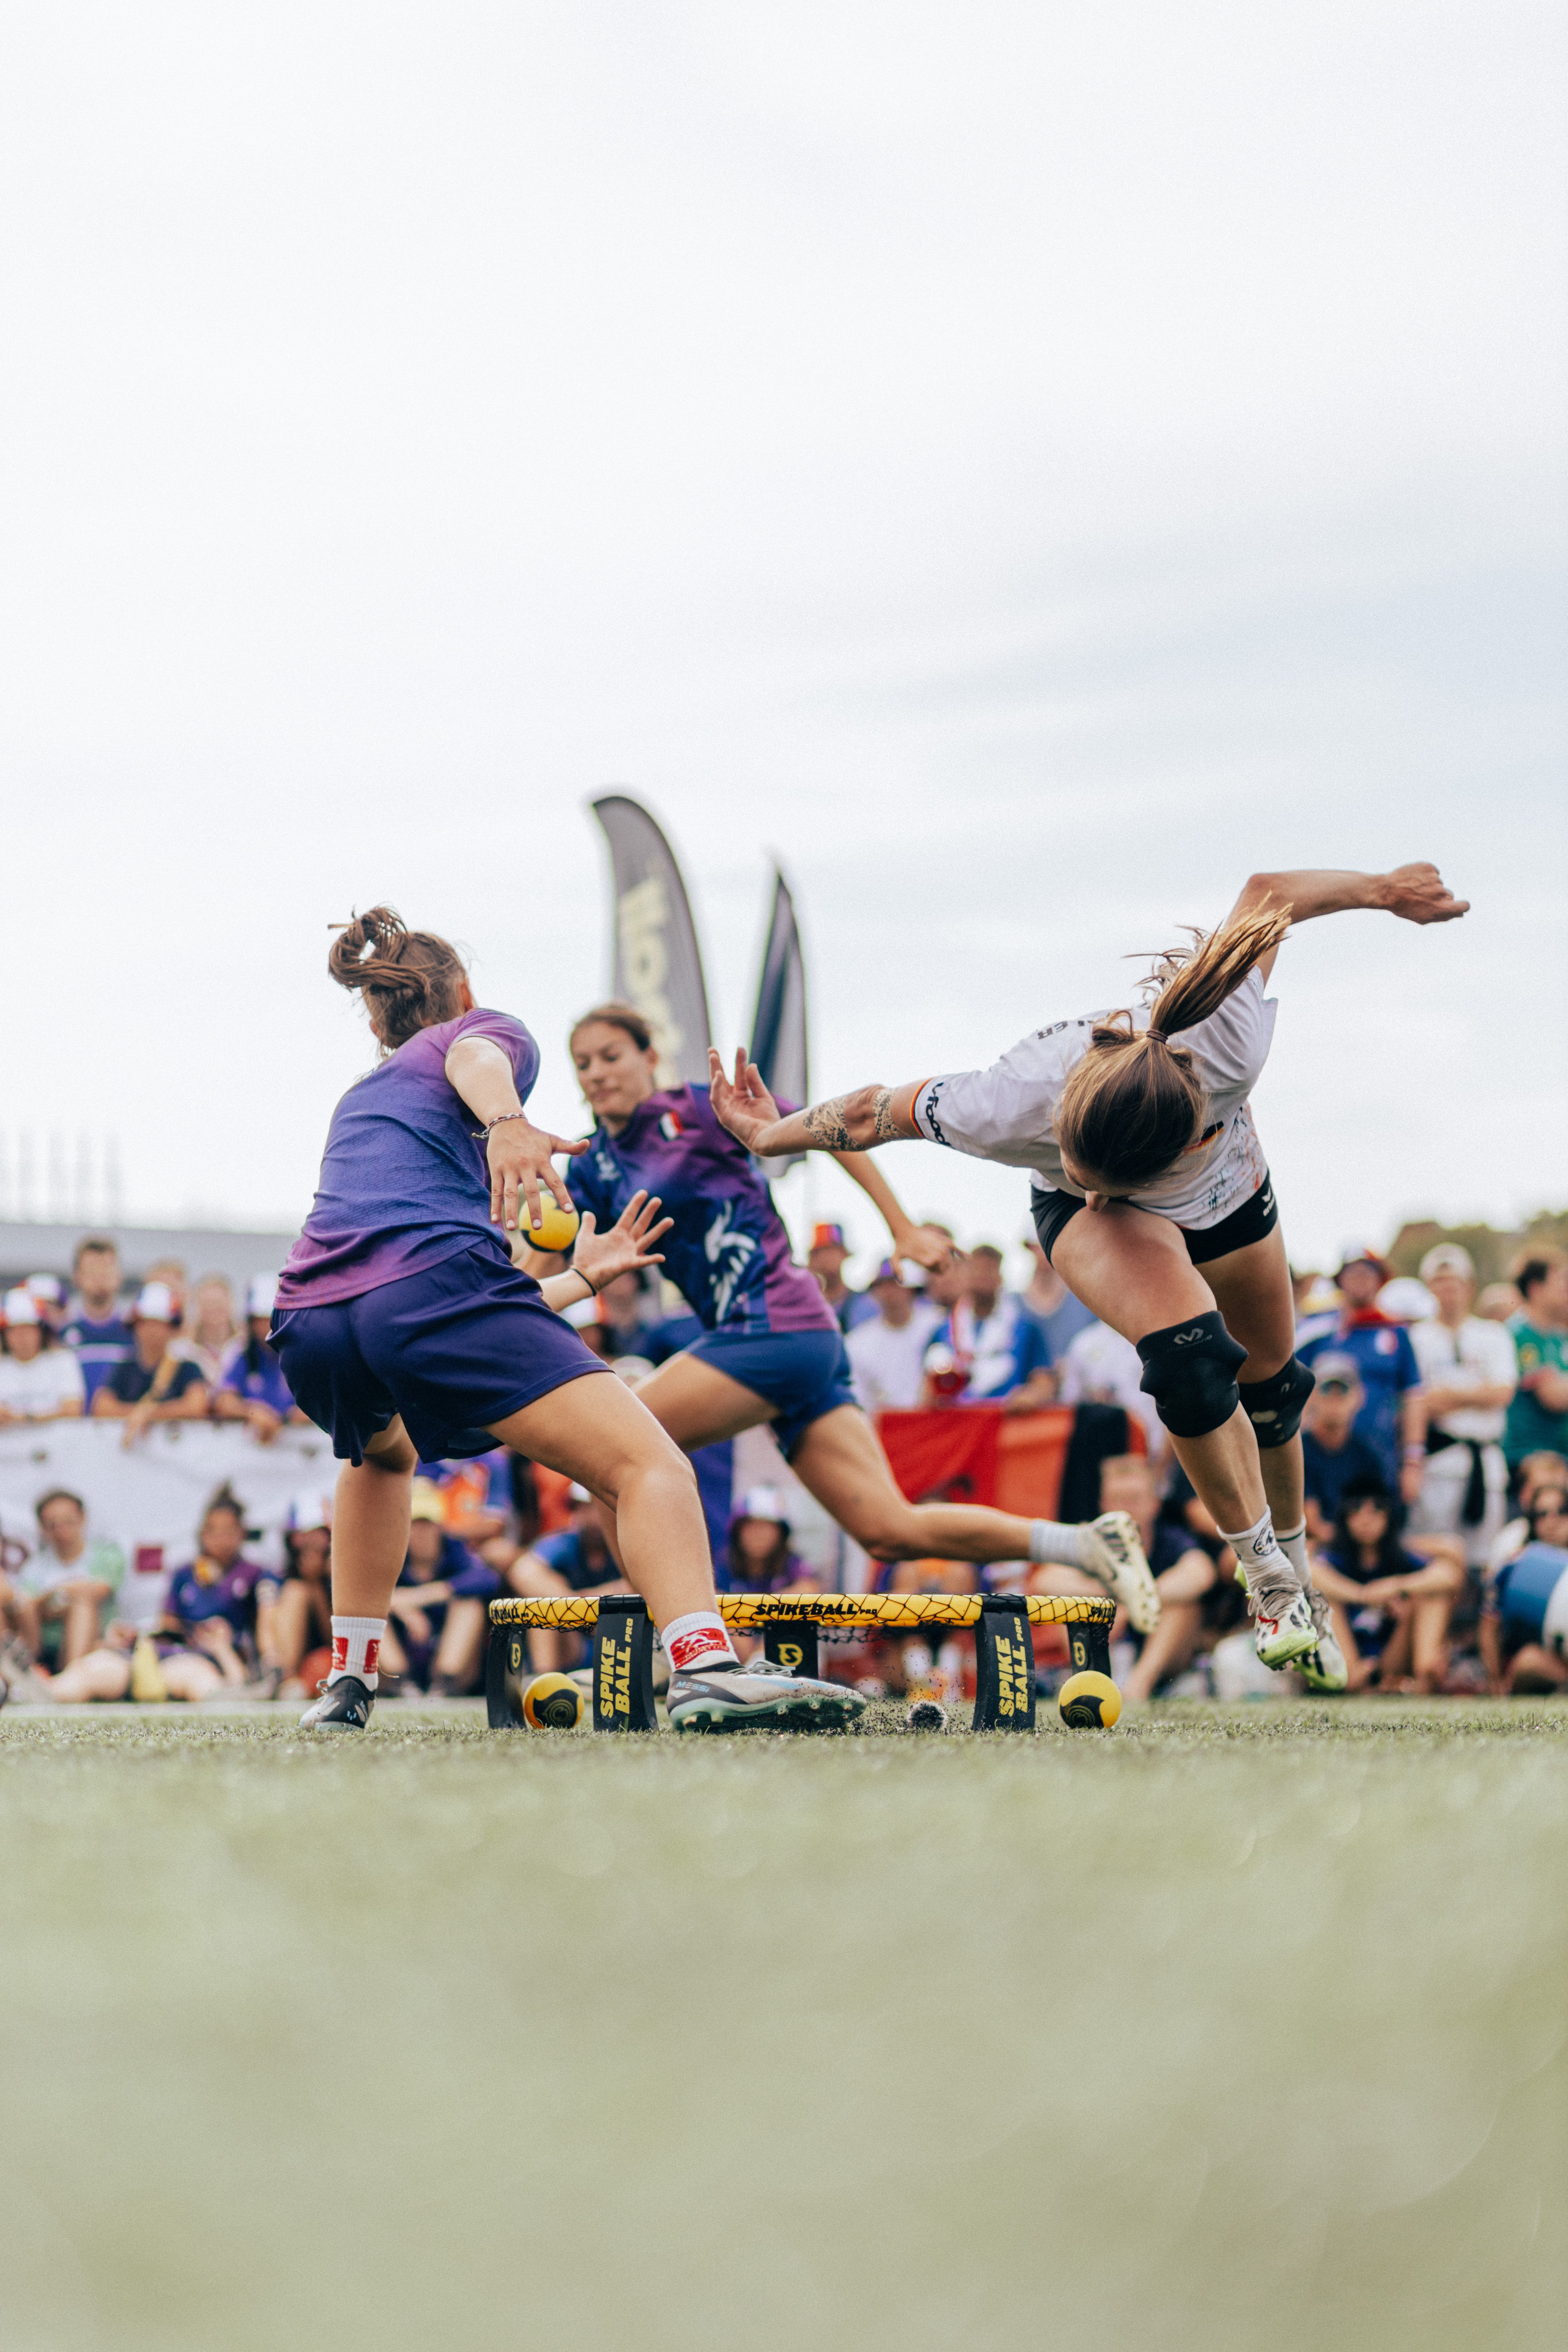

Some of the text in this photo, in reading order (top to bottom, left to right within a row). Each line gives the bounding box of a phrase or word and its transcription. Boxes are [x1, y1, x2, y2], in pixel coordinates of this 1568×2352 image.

[755, 1603, 858, 1615] SPIKEBALL
[600, 1636, 616, 1719] SPIKE
[615, 1617, 633, 1715] BALL PRO
[675, 1681, 711, 1693] MESSI
[995, 1635, 1015, 1717] SPIKE
[1012, 1617, 1028, 1713] BALL PRO
